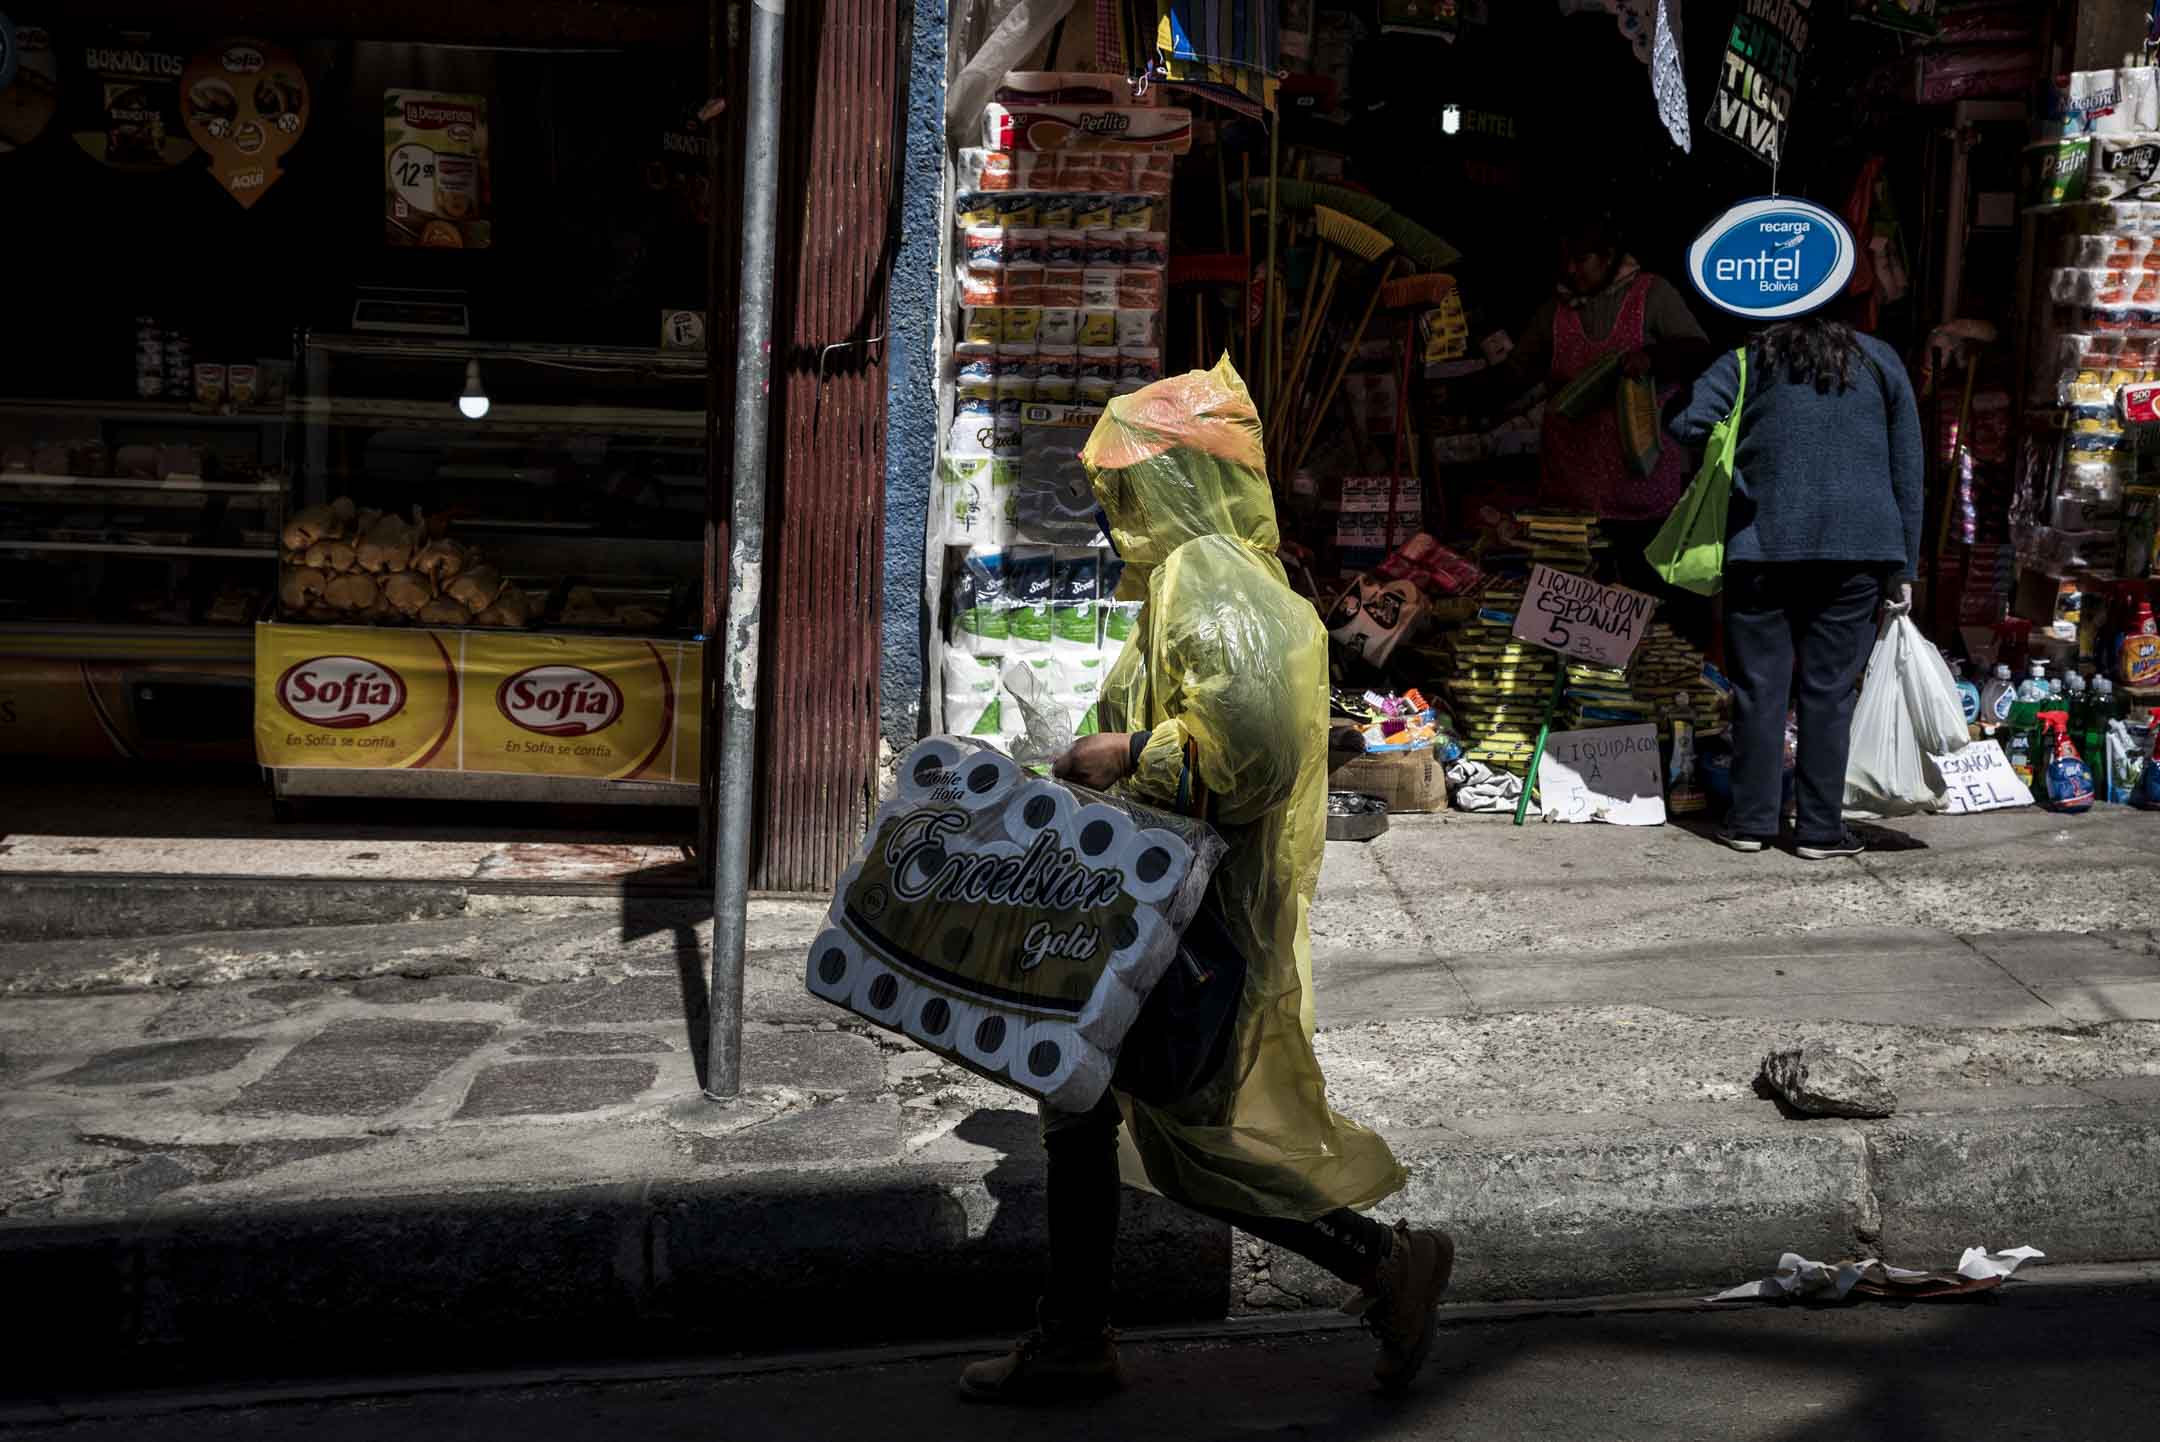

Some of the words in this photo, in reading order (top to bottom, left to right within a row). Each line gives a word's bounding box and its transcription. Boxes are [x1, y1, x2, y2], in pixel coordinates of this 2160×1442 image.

[84, 48, 184, 76] BOKADITOS
[1725, 50, 1793, 122] TIGO
[1079, 113, 1129, 131] Perlita
[1463, 109, 1517, 141] ENTEL
[1719, 88, 1781, 163] VIVA
[2111, 150, 2152, 169] Perlita
[1760, 221, 1811, 234] recarga
[1716, 249, 1800, 281] entel
[1760, 281, 1799, 292] Bolivia
[1537, 567, 1647, 619] LIQUIDACION
[1537, 591, 1632, 640] ESPONJA
[1543, 616, 1573, 647] 5
[292, 672, 391, 712] Sofía
[511, 679, 609, 721] Sofía
[286, 734, 302, 745] En
[304, 734, 337, 746] Sofía
[340, 736, 353, 746] se
[504, 740, 521, 752] En
[524, 741, 554, 754] Sofía
[557, 744, 572, 754] se
[929, 786, 965, 802] Hoja
[1568, 785, 1586, 816] 5
[887, 807, 1122, 911] Excelsior
[1020, 920, 1100, 972] Gold
